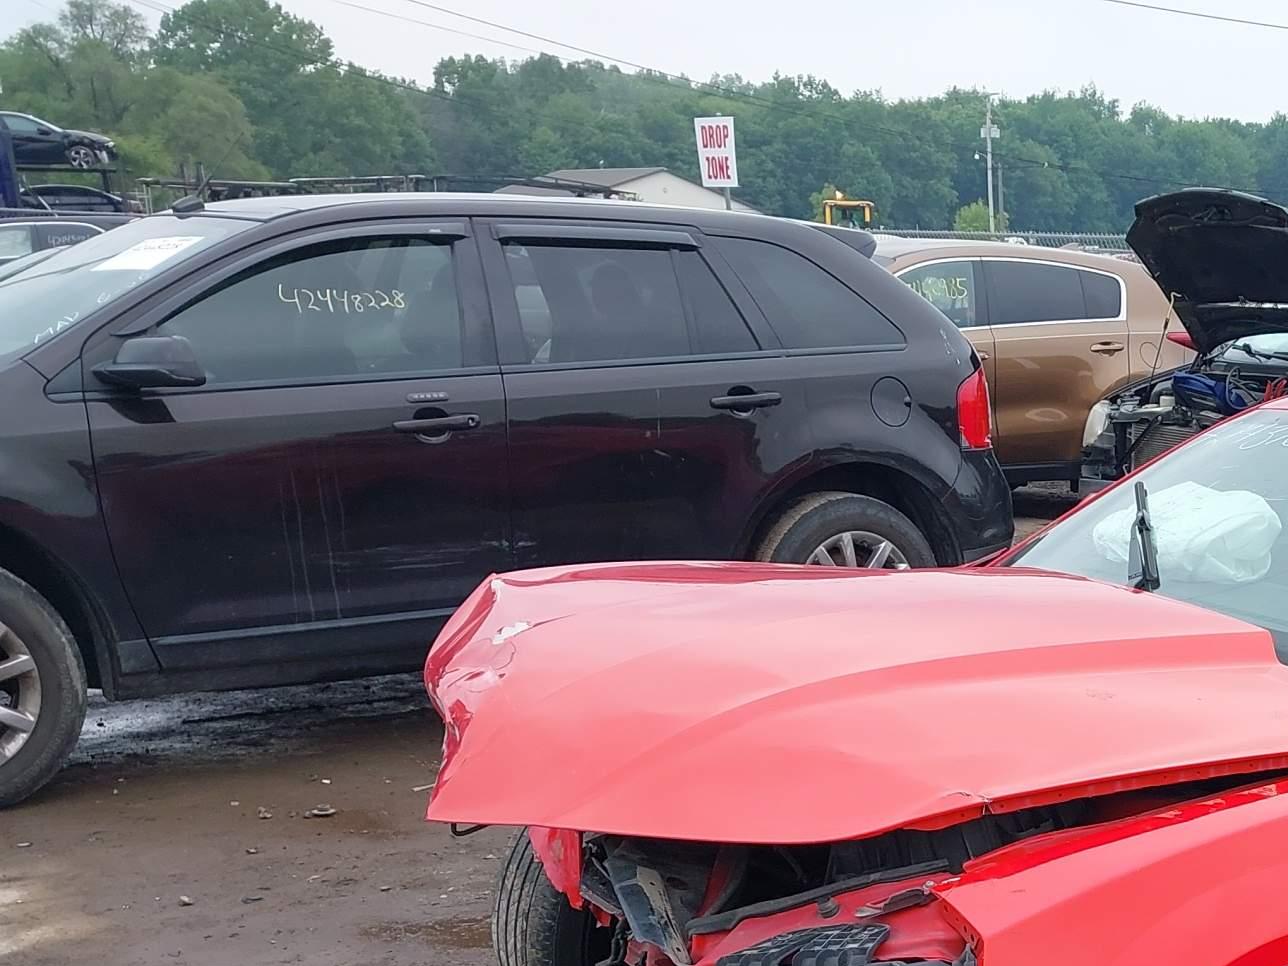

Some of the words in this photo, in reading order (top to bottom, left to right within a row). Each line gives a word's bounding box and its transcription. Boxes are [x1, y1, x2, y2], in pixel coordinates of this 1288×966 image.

[701, 125, 729, 148] DROP
[706, 156, 731, 180] ZONE
[278, 284, 405, 313] 42448228
